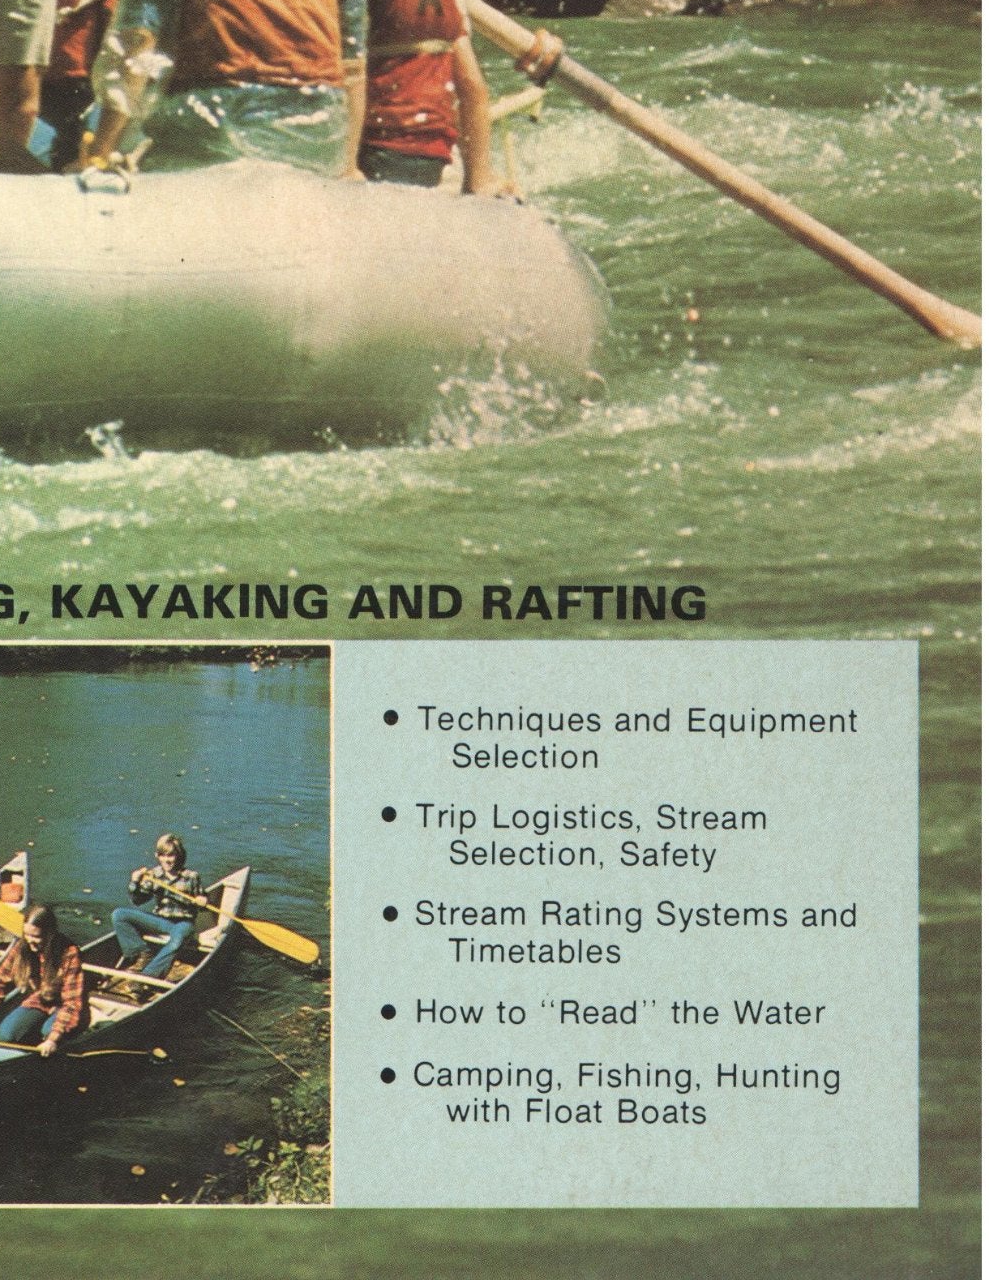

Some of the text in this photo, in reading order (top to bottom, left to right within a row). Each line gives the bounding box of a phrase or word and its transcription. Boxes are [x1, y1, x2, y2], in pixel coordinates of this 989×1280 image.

[51, 583, 329, 620] KAYAKING
[348, 584, 463, 620] AND
[482, 584, 708, 621] RAFTING
[417, 705, 858, 739] Techniques and Equipment
[452, 742, 599, 769] Selection
[415, 803, 767, 836] Trip Logistics, Stream
[449, 839, 718, 873] Selection, Safety
[415, 899, 858, 933] Stream Rating Systems and
[448, 937, 622, 965] Timetables
[416, 998, 485, 1025] How
[496, 1000, 527, 1025] to
[670, 999, 720, 1025] the
[733, 999, 827, 1026] Water
[413, 1061, 841, 1094] Camping, Fishing, Hunting
[446, 1099, 708, 1125] with Float Boats
